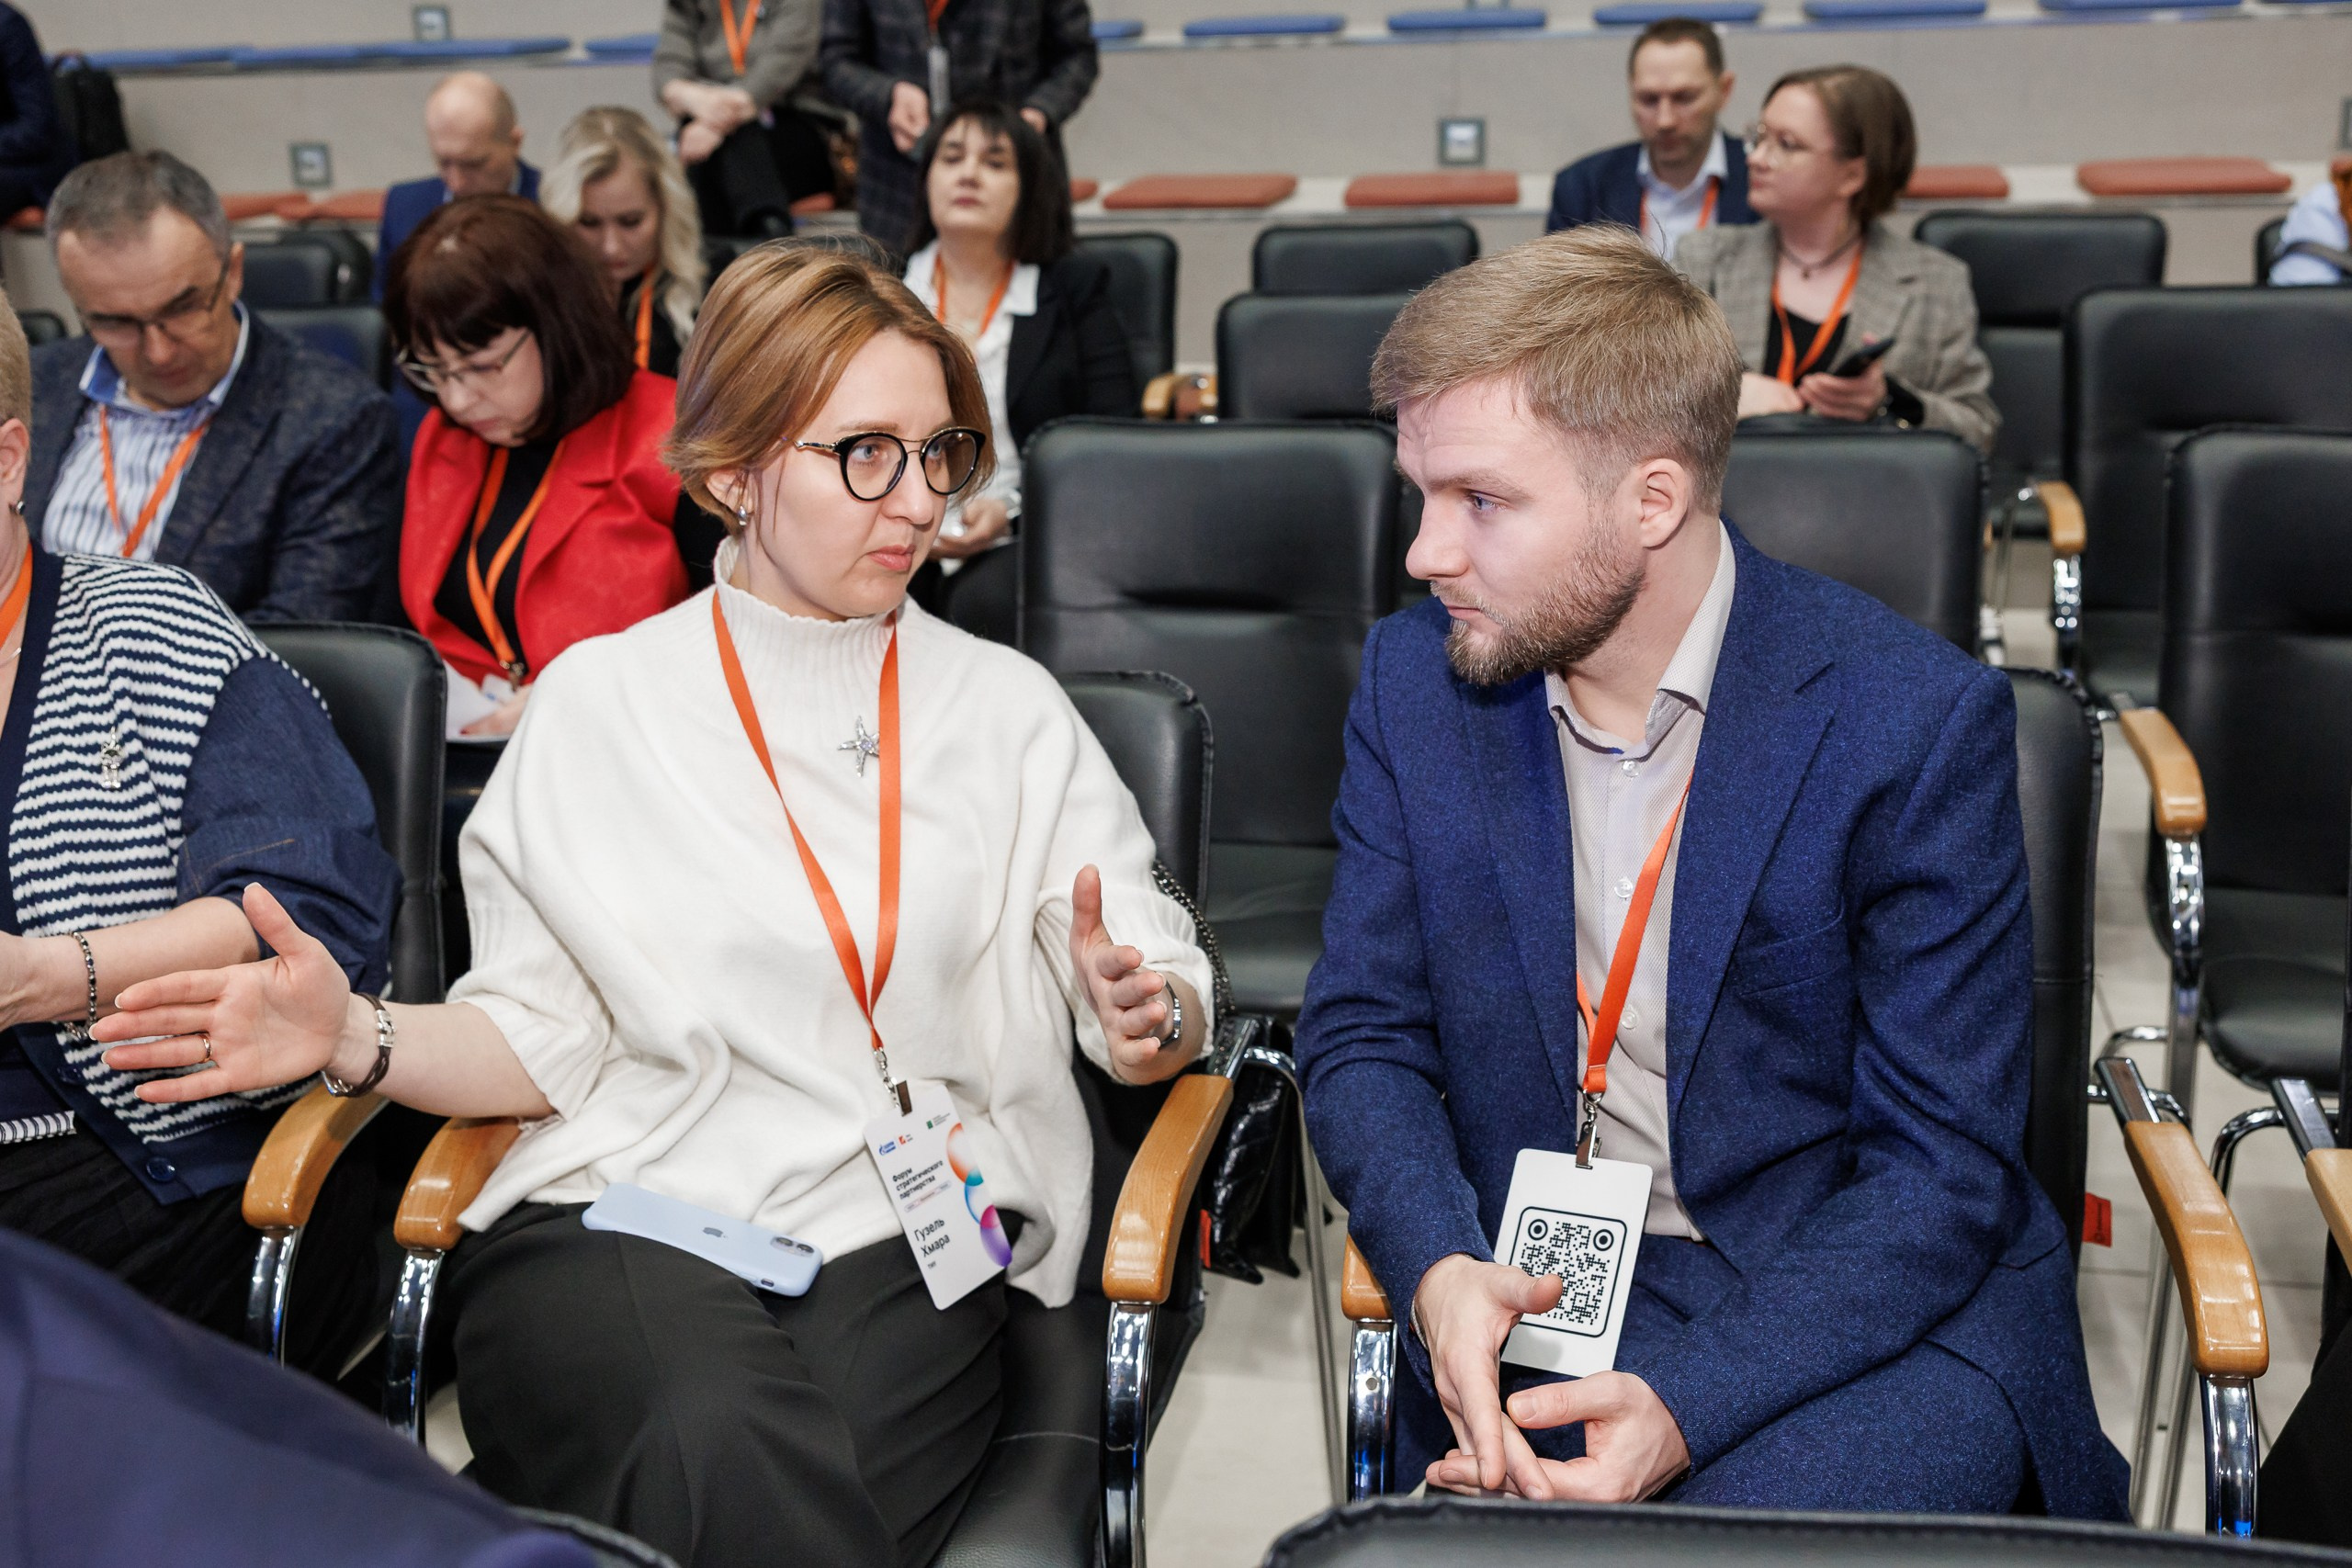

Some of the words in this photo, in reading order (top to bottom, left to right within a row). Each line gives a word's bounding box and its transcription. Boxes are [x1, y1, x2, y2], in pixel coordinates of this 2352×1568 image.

[892, 1168, 912, 1182] Форум
[896, 1160, 944, 1191] стратегического
[899, 1175, 935, 1200] партнерства
[914, 1218, 944, 1242] Гузель
[921, 1235, 950, 1258] Хмара
